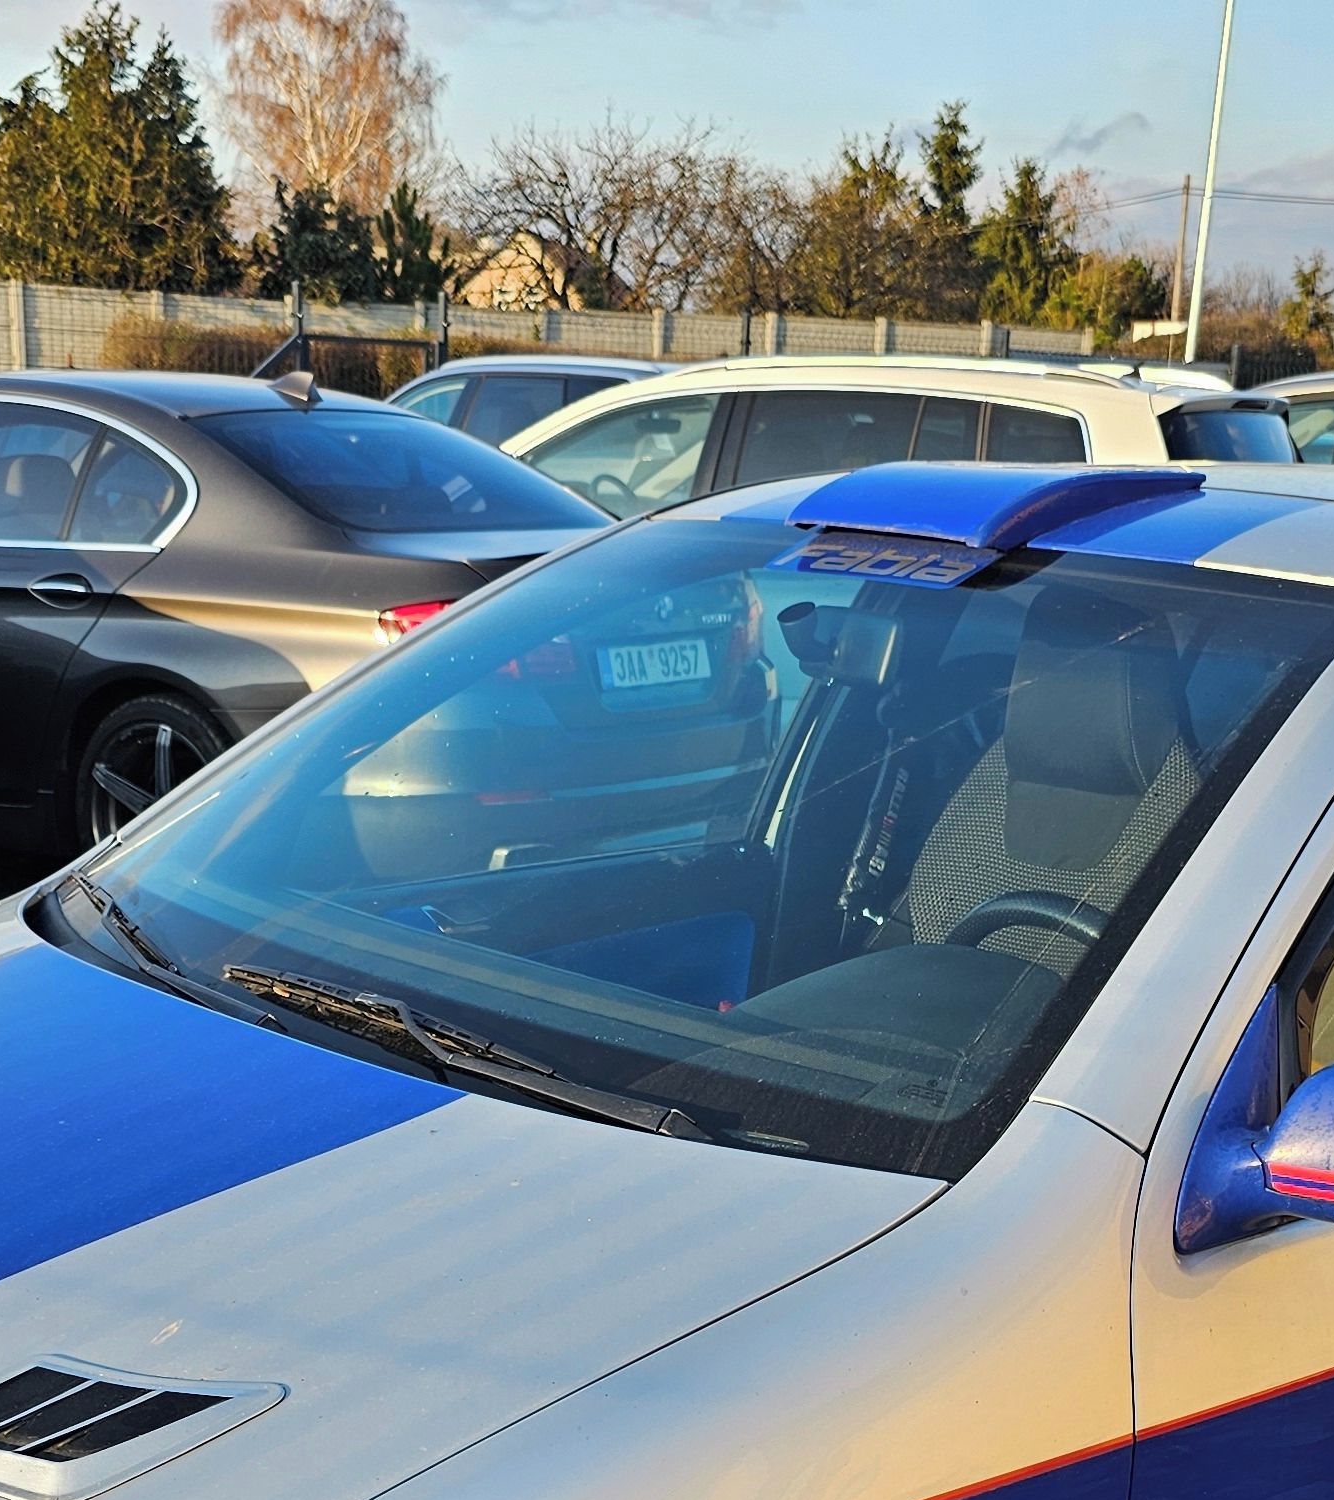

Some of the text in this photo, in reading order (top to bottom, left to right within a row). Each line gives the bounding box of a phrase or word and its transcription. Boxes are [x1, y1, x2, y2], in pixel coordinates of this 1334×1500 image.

[774, 544, 976, 583] Fabia
[616, 644, 699, 682] 3AA 9257
